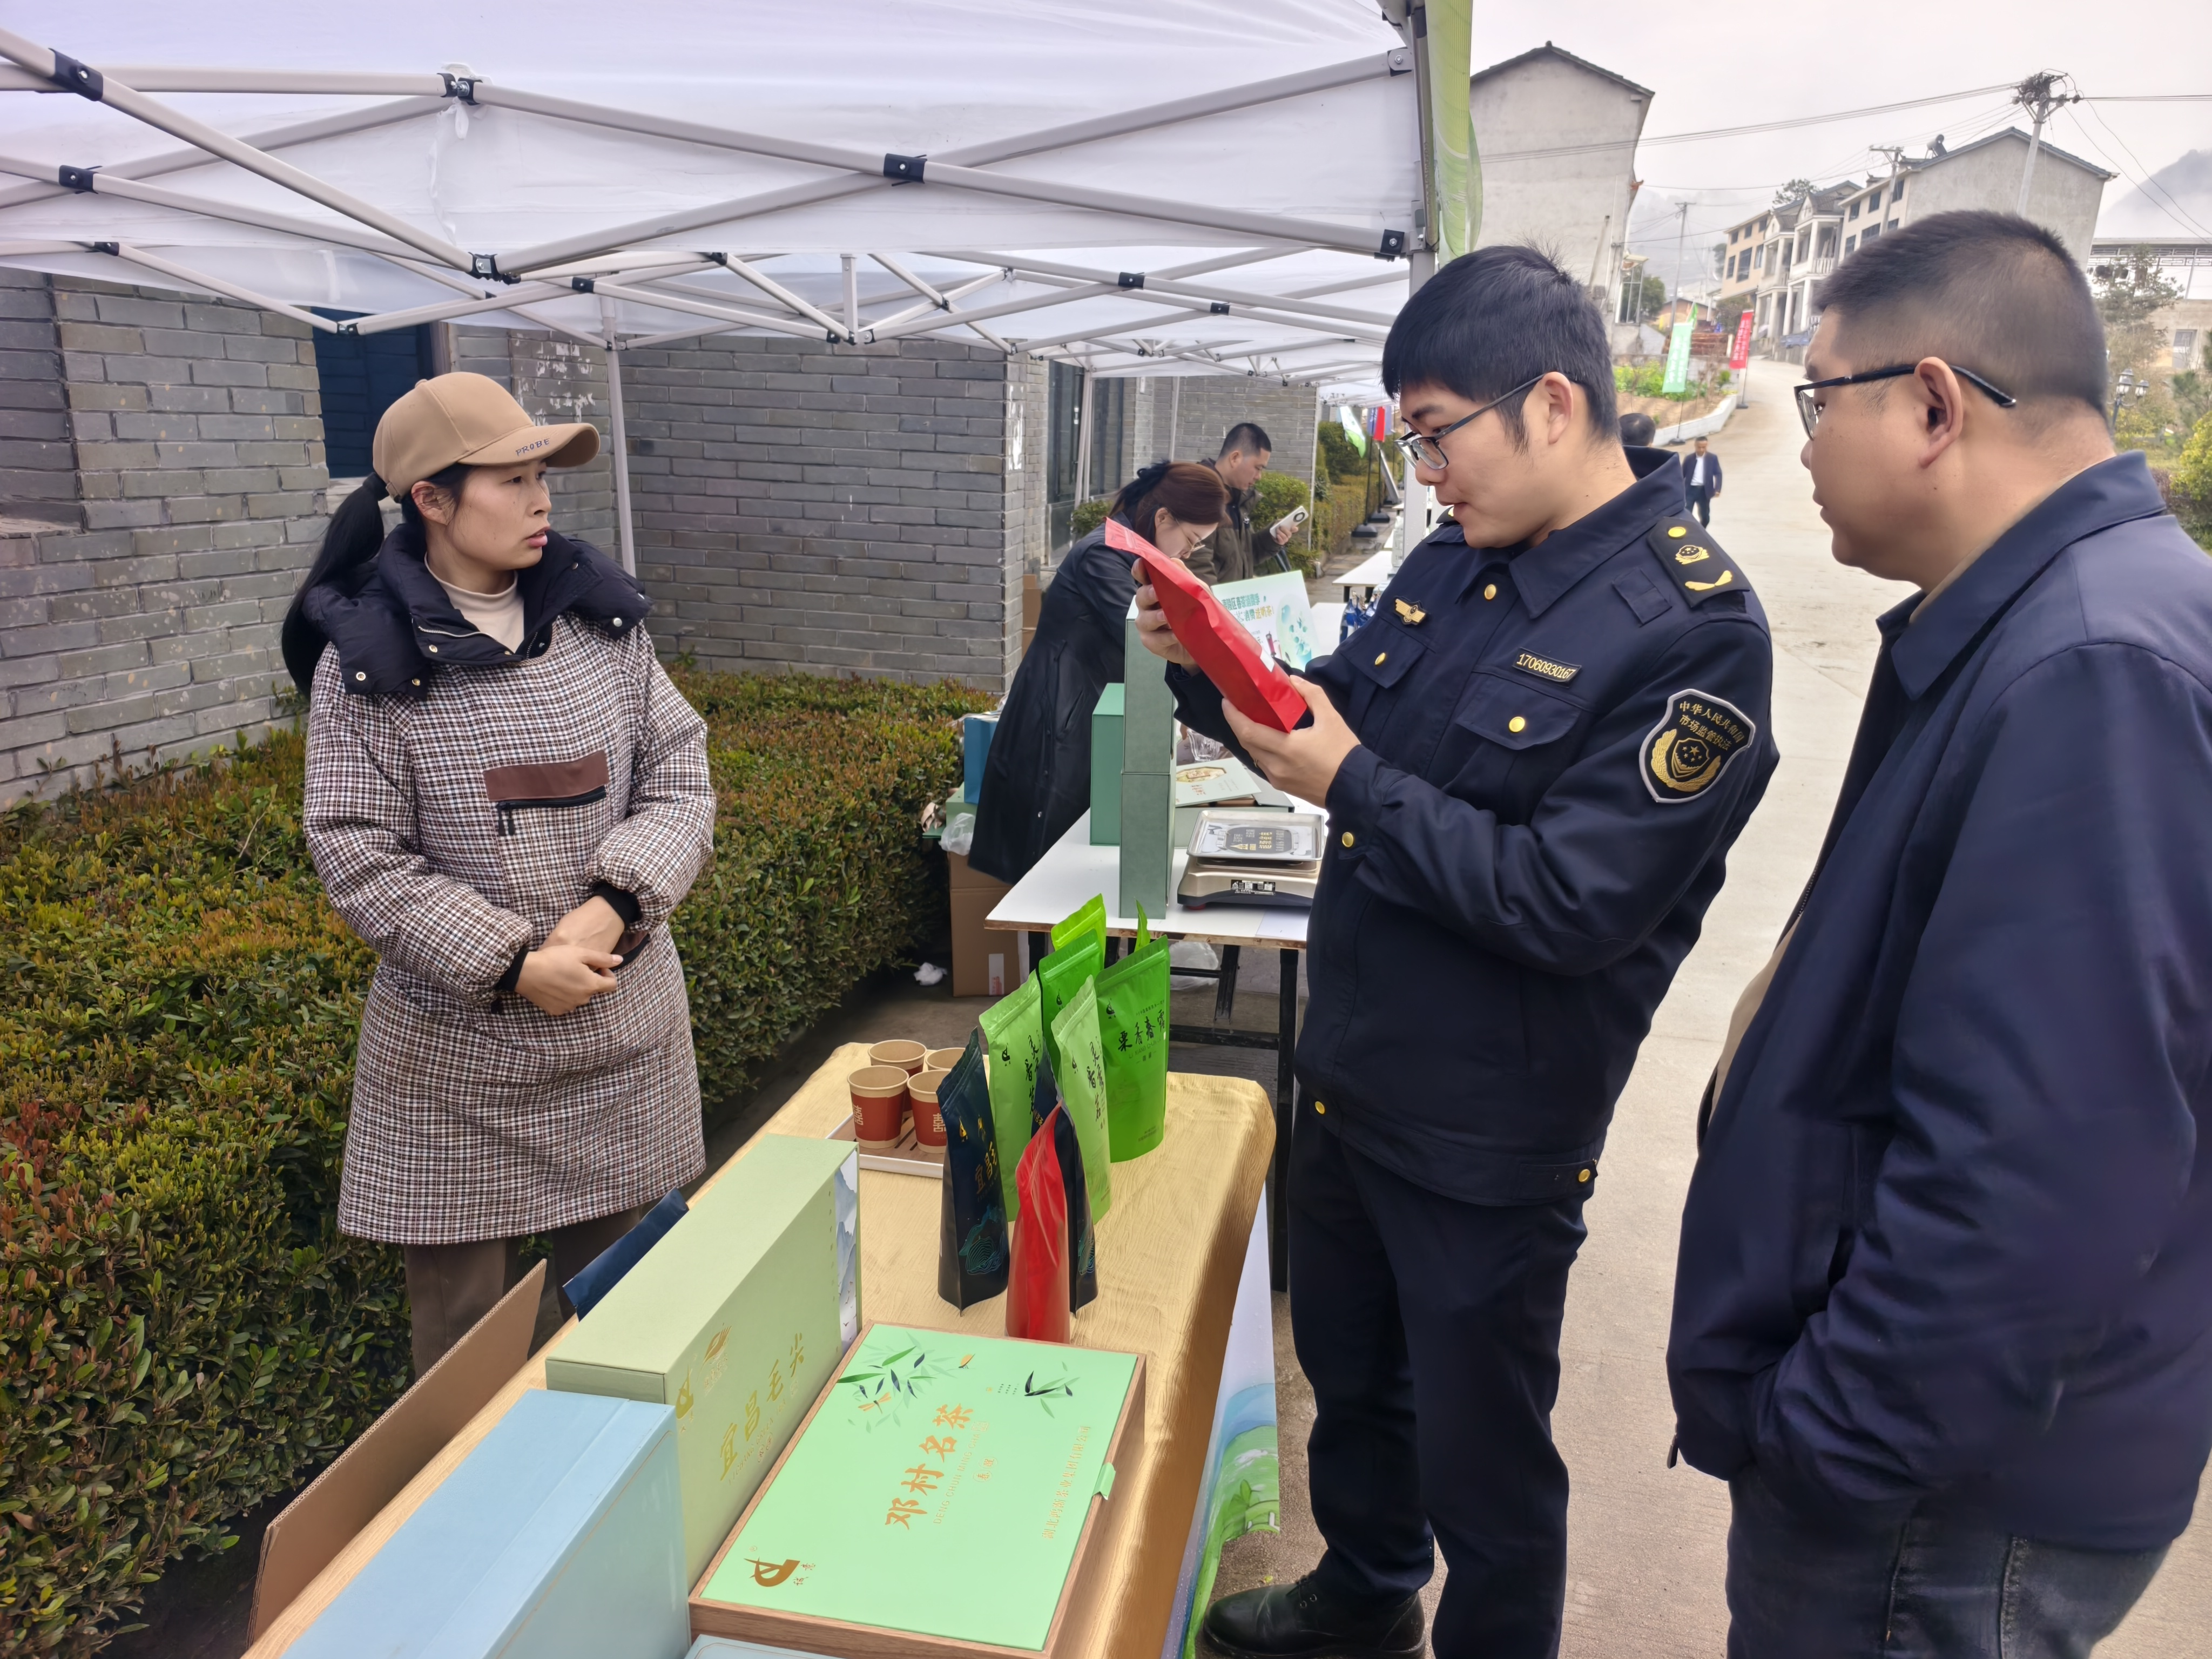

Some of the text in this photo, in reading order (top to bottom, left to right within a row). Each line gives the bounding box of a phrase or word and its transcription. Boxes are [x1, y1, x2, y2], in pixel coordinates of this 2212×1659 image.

[515, 438, 550, 456] PROBE
[1516, 653, 1576, 679] 17060930167
[1679, 714, 1732, 751] 市场监管执法
[1680, 701, 1745, 743] 中华人民共和国
[720, 1332, 804, 1481] 宜昌毛尖
[885, 1403, 973, 1530] 邓村名茶
[933, 1500, 949, 1524] DENG
[946, 1474, 962, 1497] CHUN
[957, 1451, 972, 1471] MING
[968, 1433, 981, 1449] CHA
